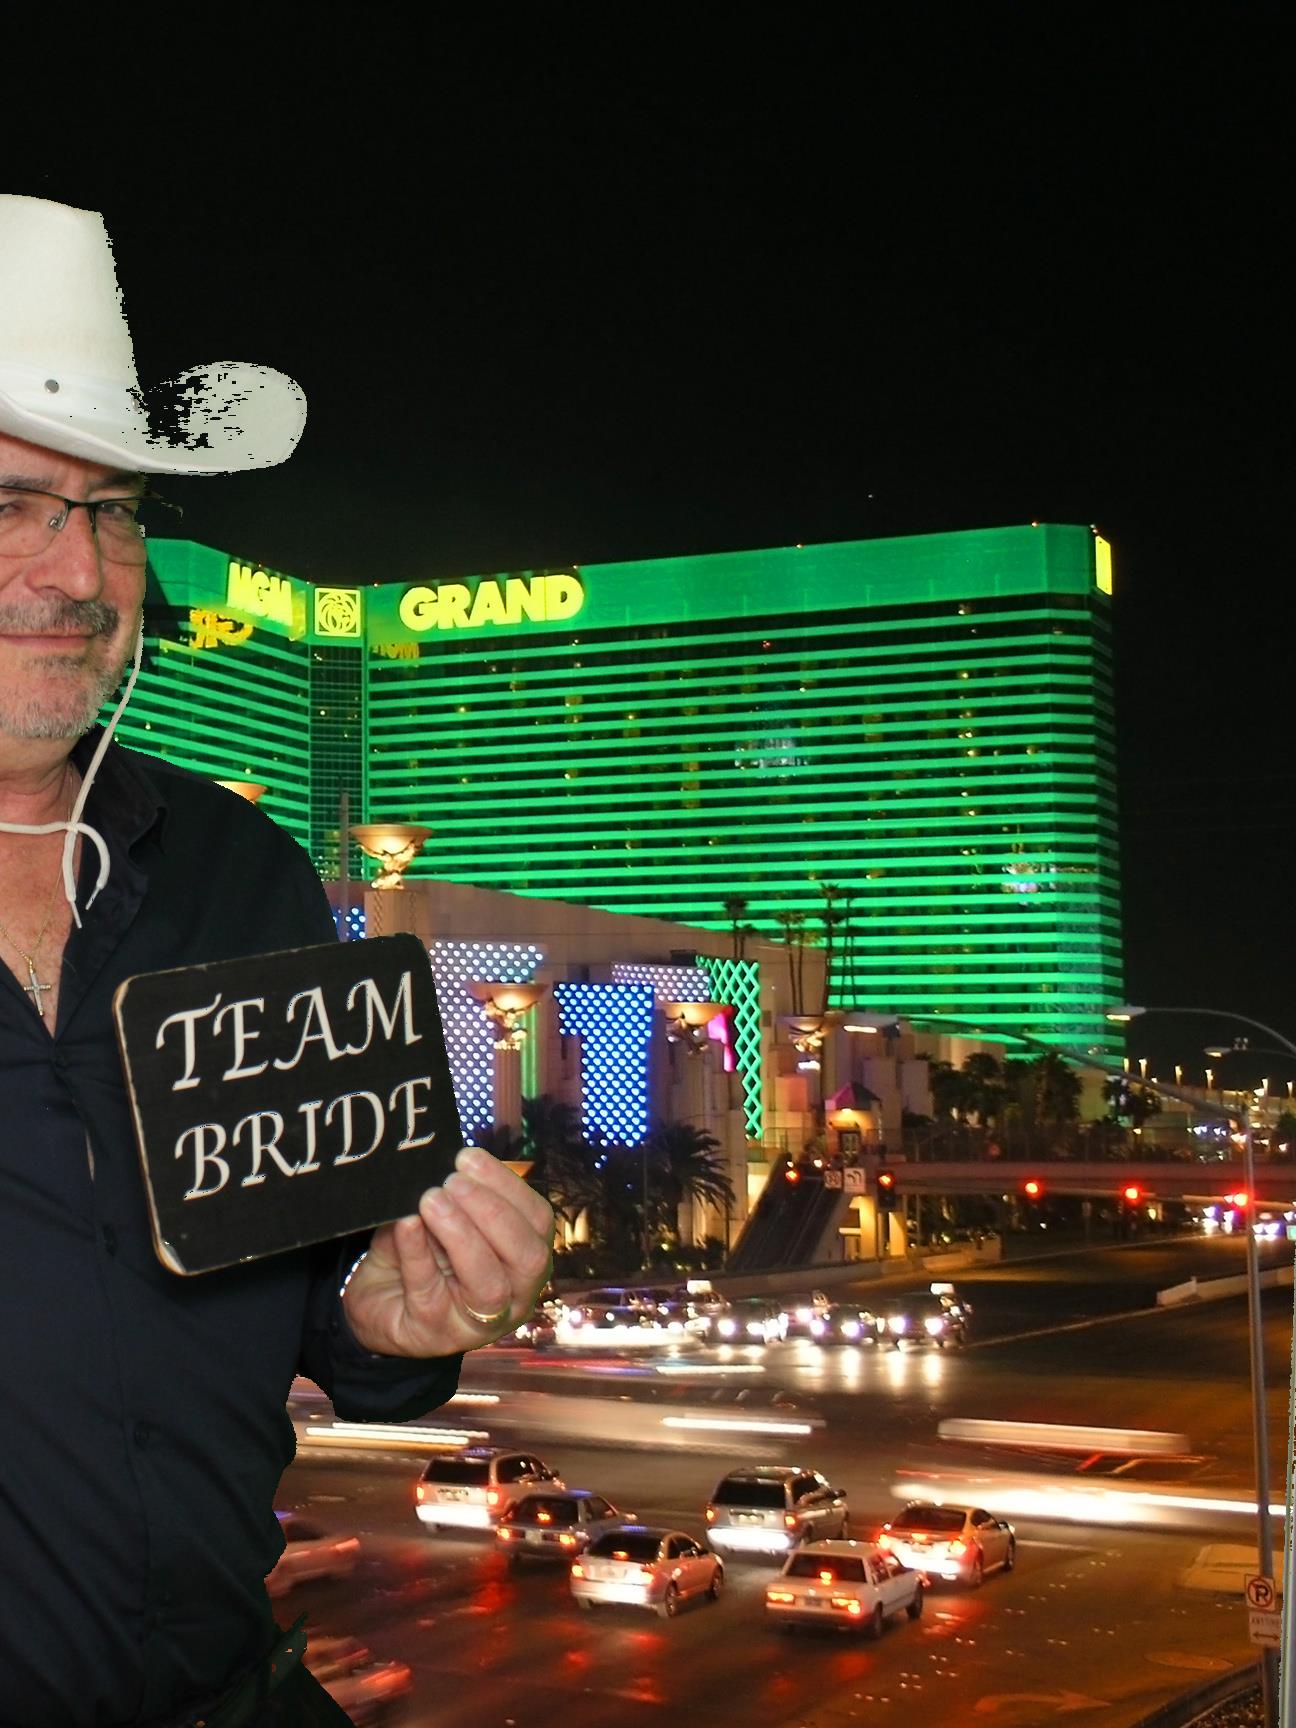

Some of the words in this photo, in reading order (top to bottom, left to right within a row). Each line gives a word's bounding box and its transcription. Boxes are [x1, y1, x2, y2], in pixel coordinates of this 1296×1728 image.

[226, 562, 294, 627] MGM
[399, 575, 585, 631] GRAND
[155, 970, 423, 1091] TEAM
[174, 1076, 436, 1200] BRIDE
